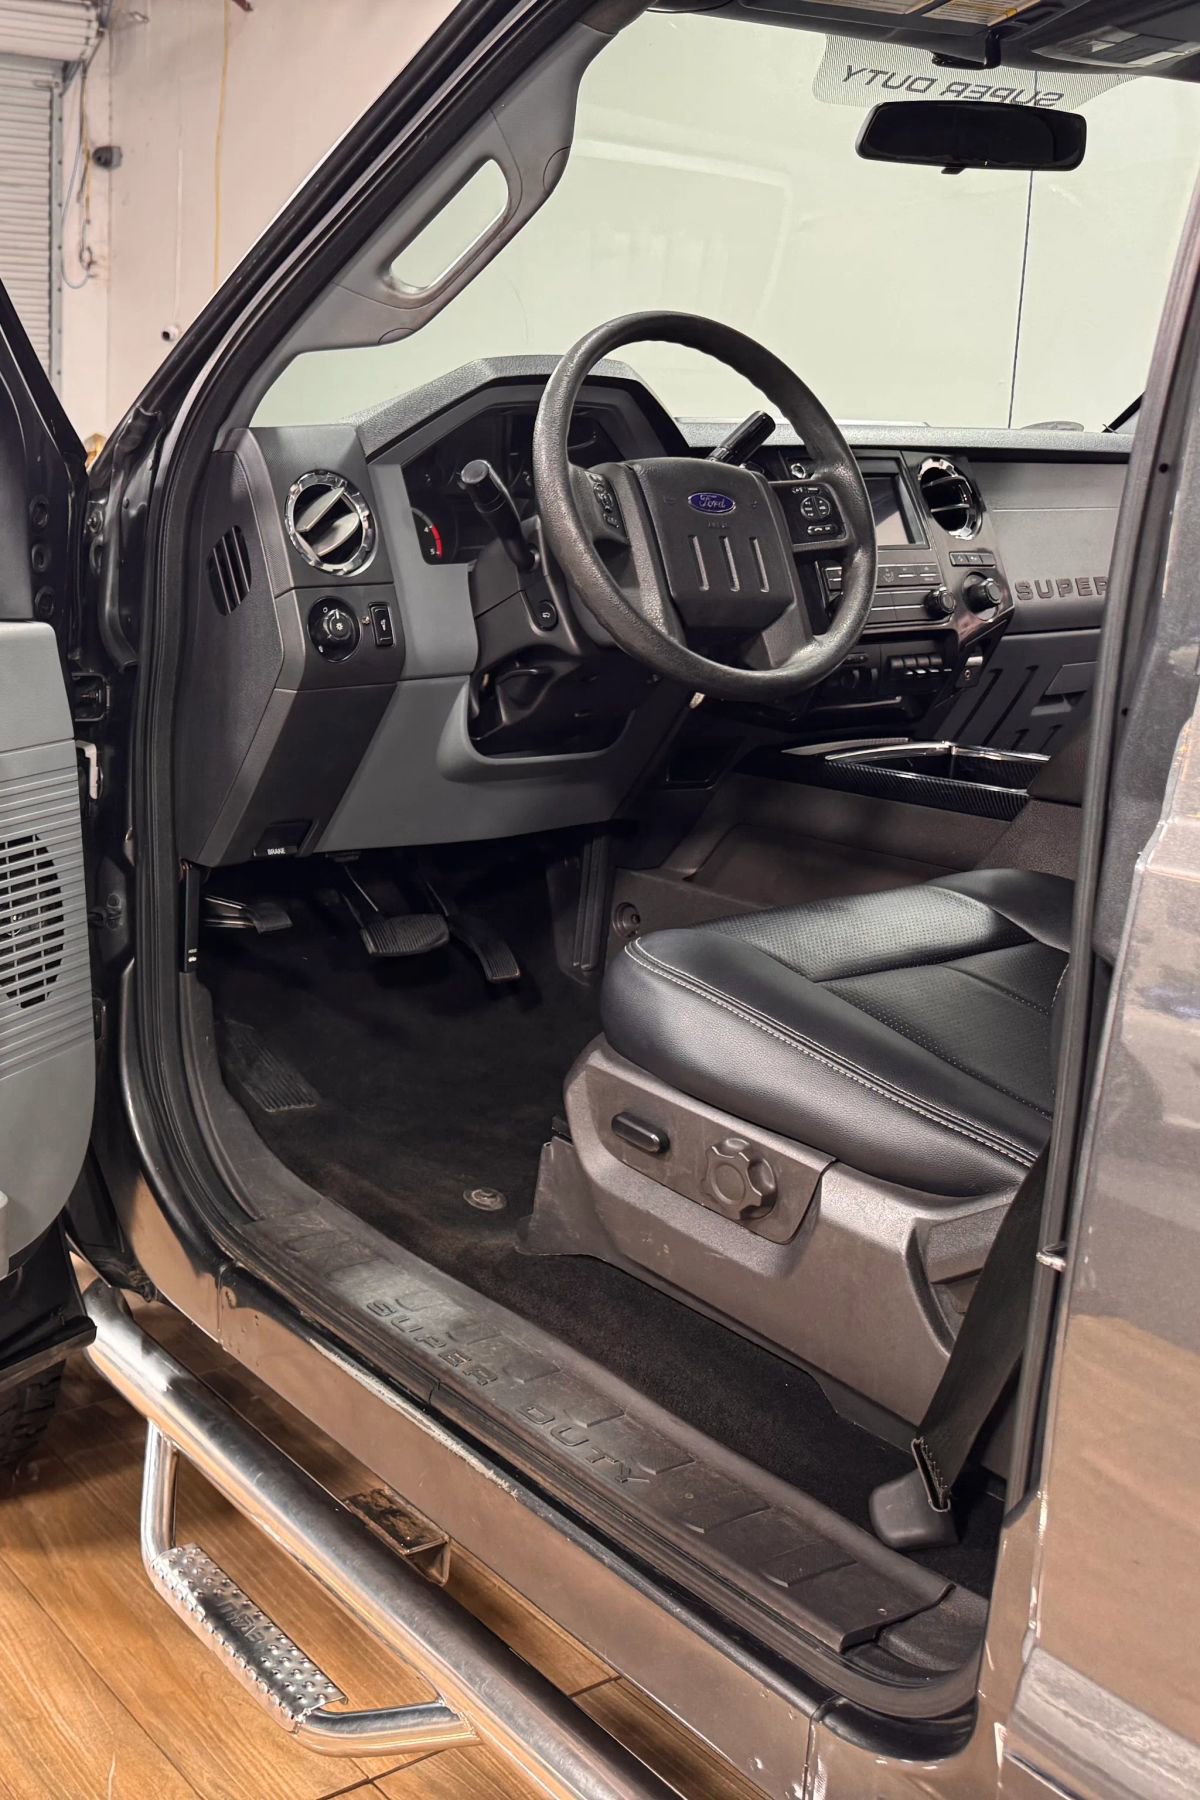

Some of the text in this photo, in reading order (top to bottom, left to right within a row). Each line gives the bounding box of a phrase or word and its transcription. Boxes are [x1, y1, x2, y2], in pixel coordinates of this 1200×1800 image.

[267, 847, 286, 856] BRAKE
[366, 1301, 650, 1483] SUPER DUTY
